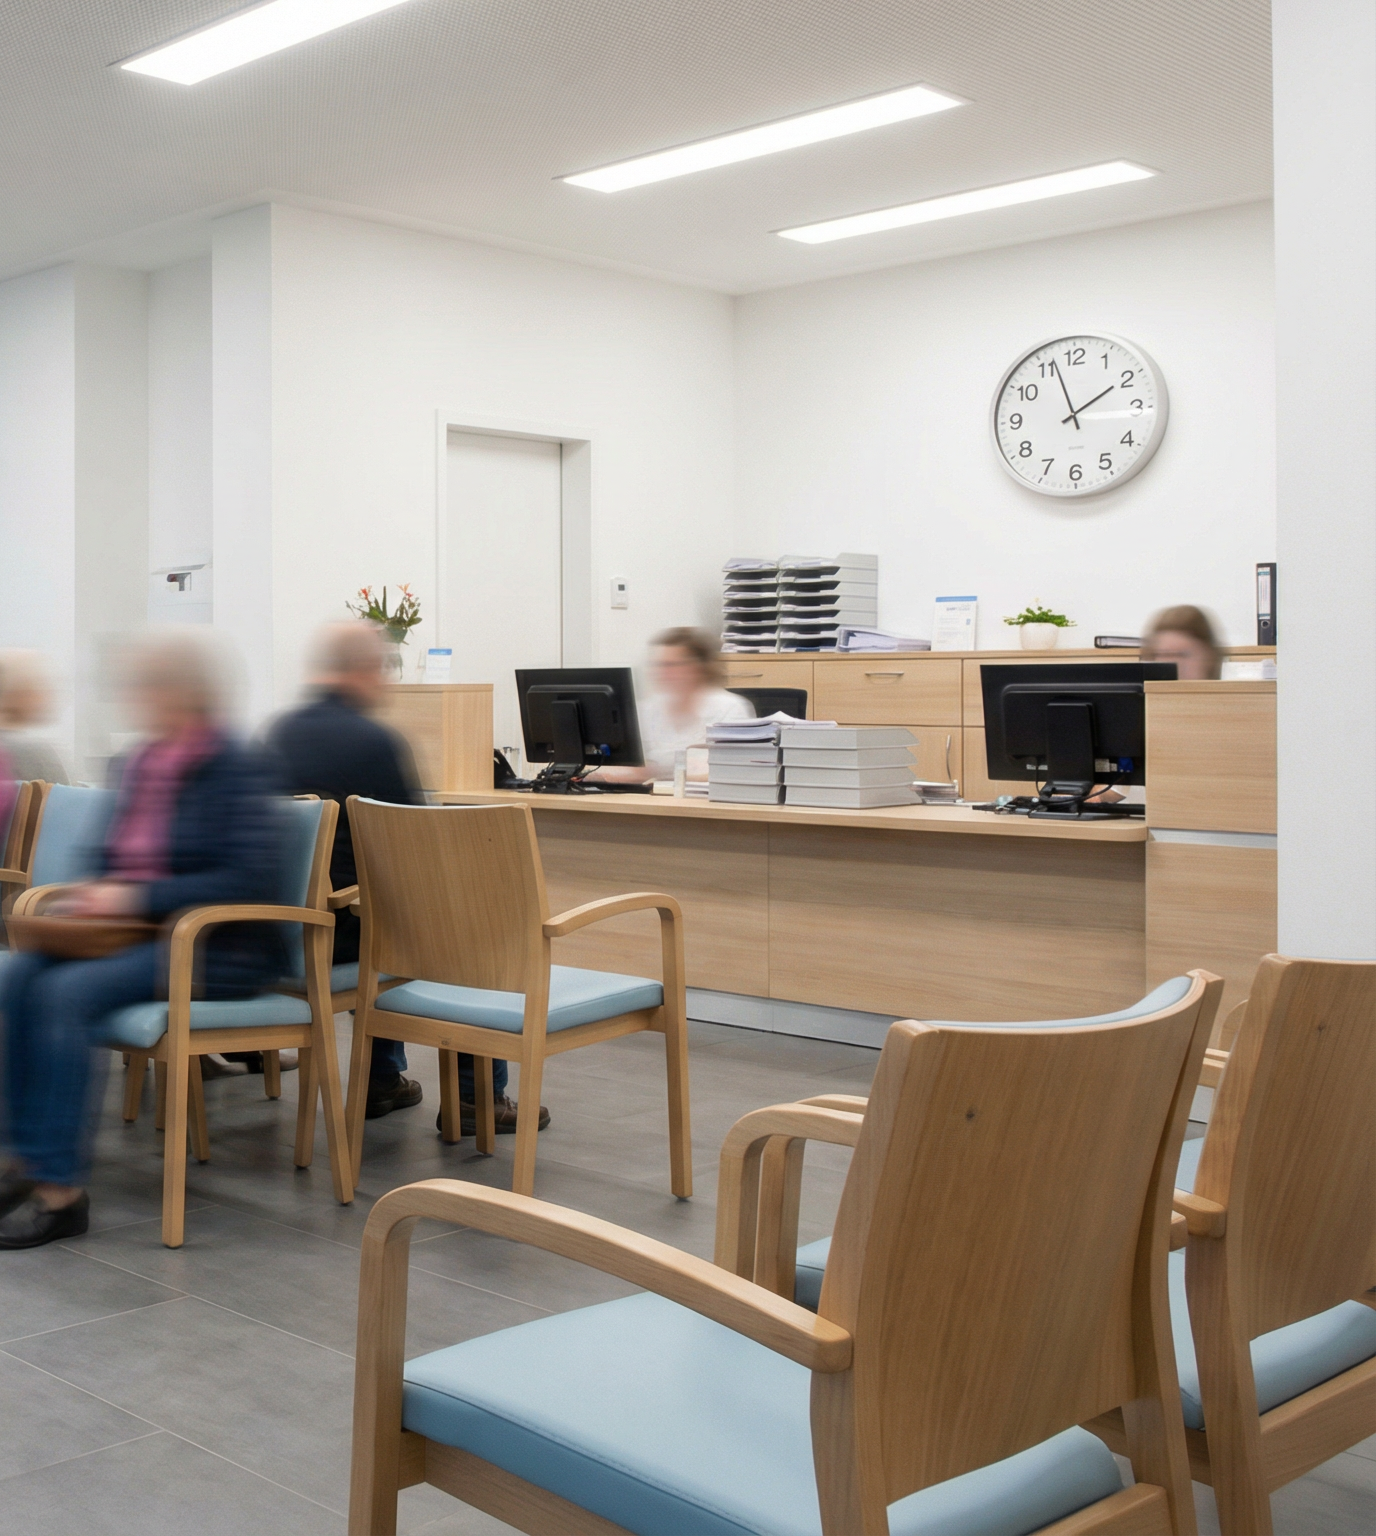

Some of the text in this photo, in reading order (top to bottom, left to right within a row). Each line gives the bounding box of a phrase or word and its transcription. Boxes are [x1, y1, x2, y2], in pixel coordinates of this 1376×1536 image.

[1063, 347, 1087, 367] 12
[1100, 352, 1109, 370] 1
[1037, 361, 1055, 378] 11
[1120, 370, 1135, 389] 2
[1016, 383, 1039, 402] 10
[1129, 398, 1144, 418] 3
[1009, 412, 1024, 431] 9
[1119, 429, 1135, 448] 4
[1018, 440, 1033, 459] 8
[1041, 457, 1056, 476] 7
[1098, 452, 1113, 471] 5
[1068, 463, 1083, 482] 6
